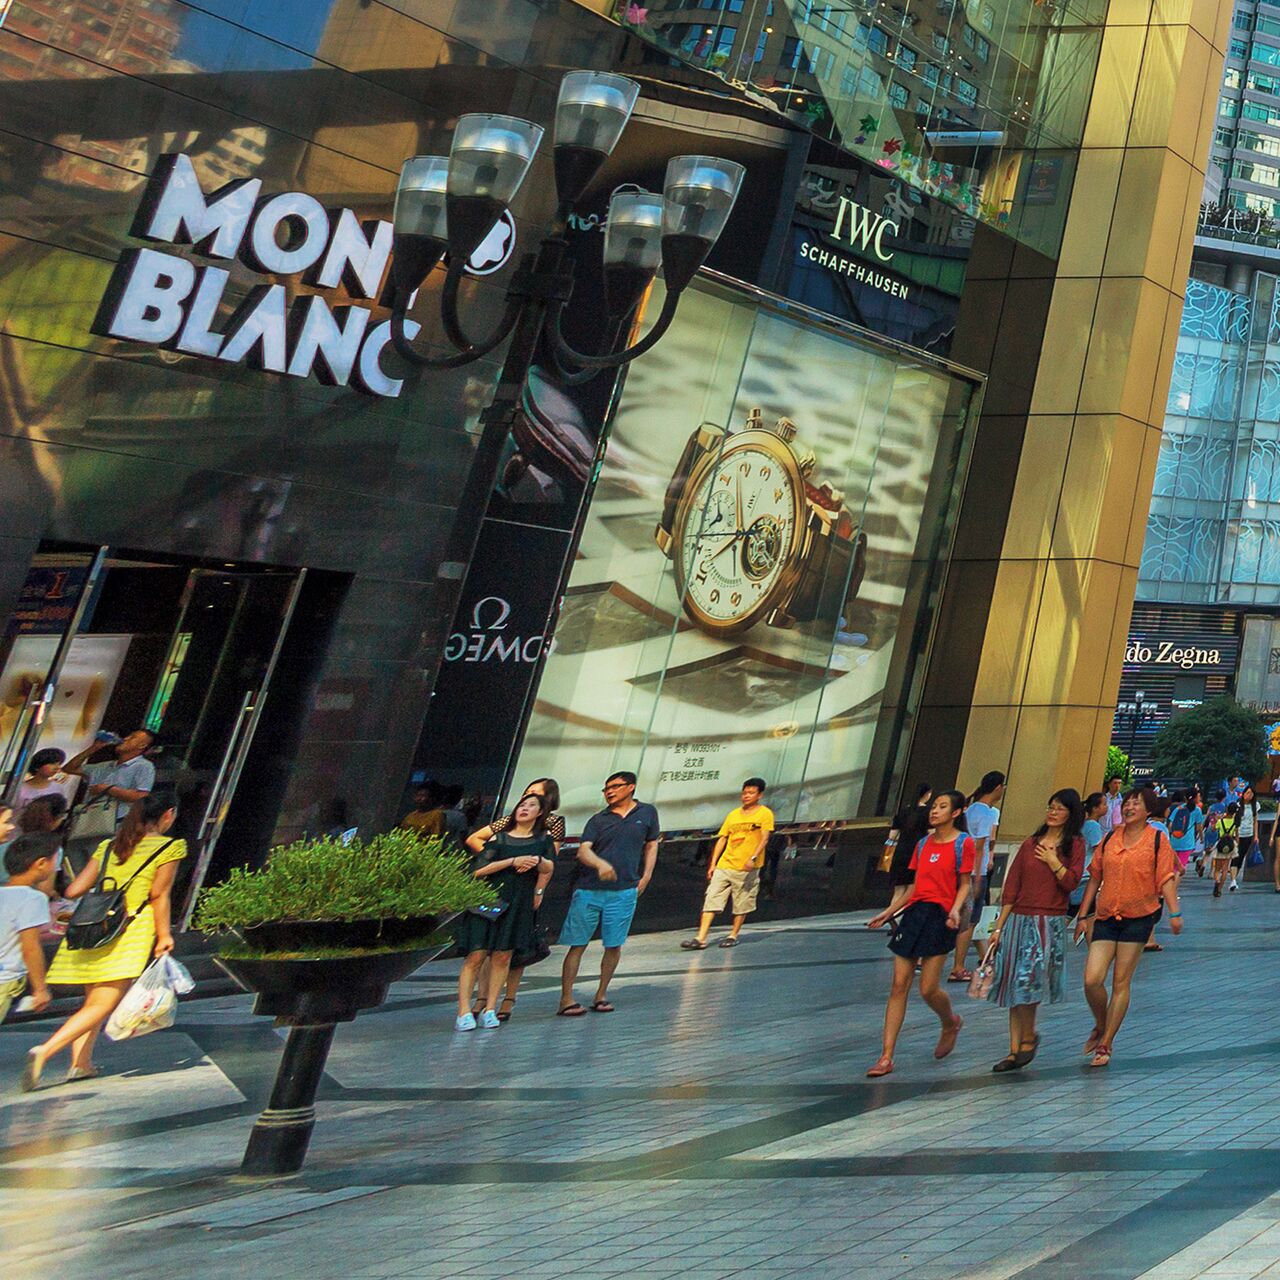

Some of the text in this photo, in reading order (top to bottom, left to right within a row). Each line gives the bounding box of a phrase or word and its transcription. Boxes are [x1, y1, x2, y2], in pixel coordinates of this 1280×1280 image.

[132, 152, 448, 310] MON
[830, 196, 899, 263] IWC
[800, 241, 910, 300] SCHAFFHAUSEN
[92, 247, 422, 398] BLANC
[1155, 642, 1221, 669] Zegna
